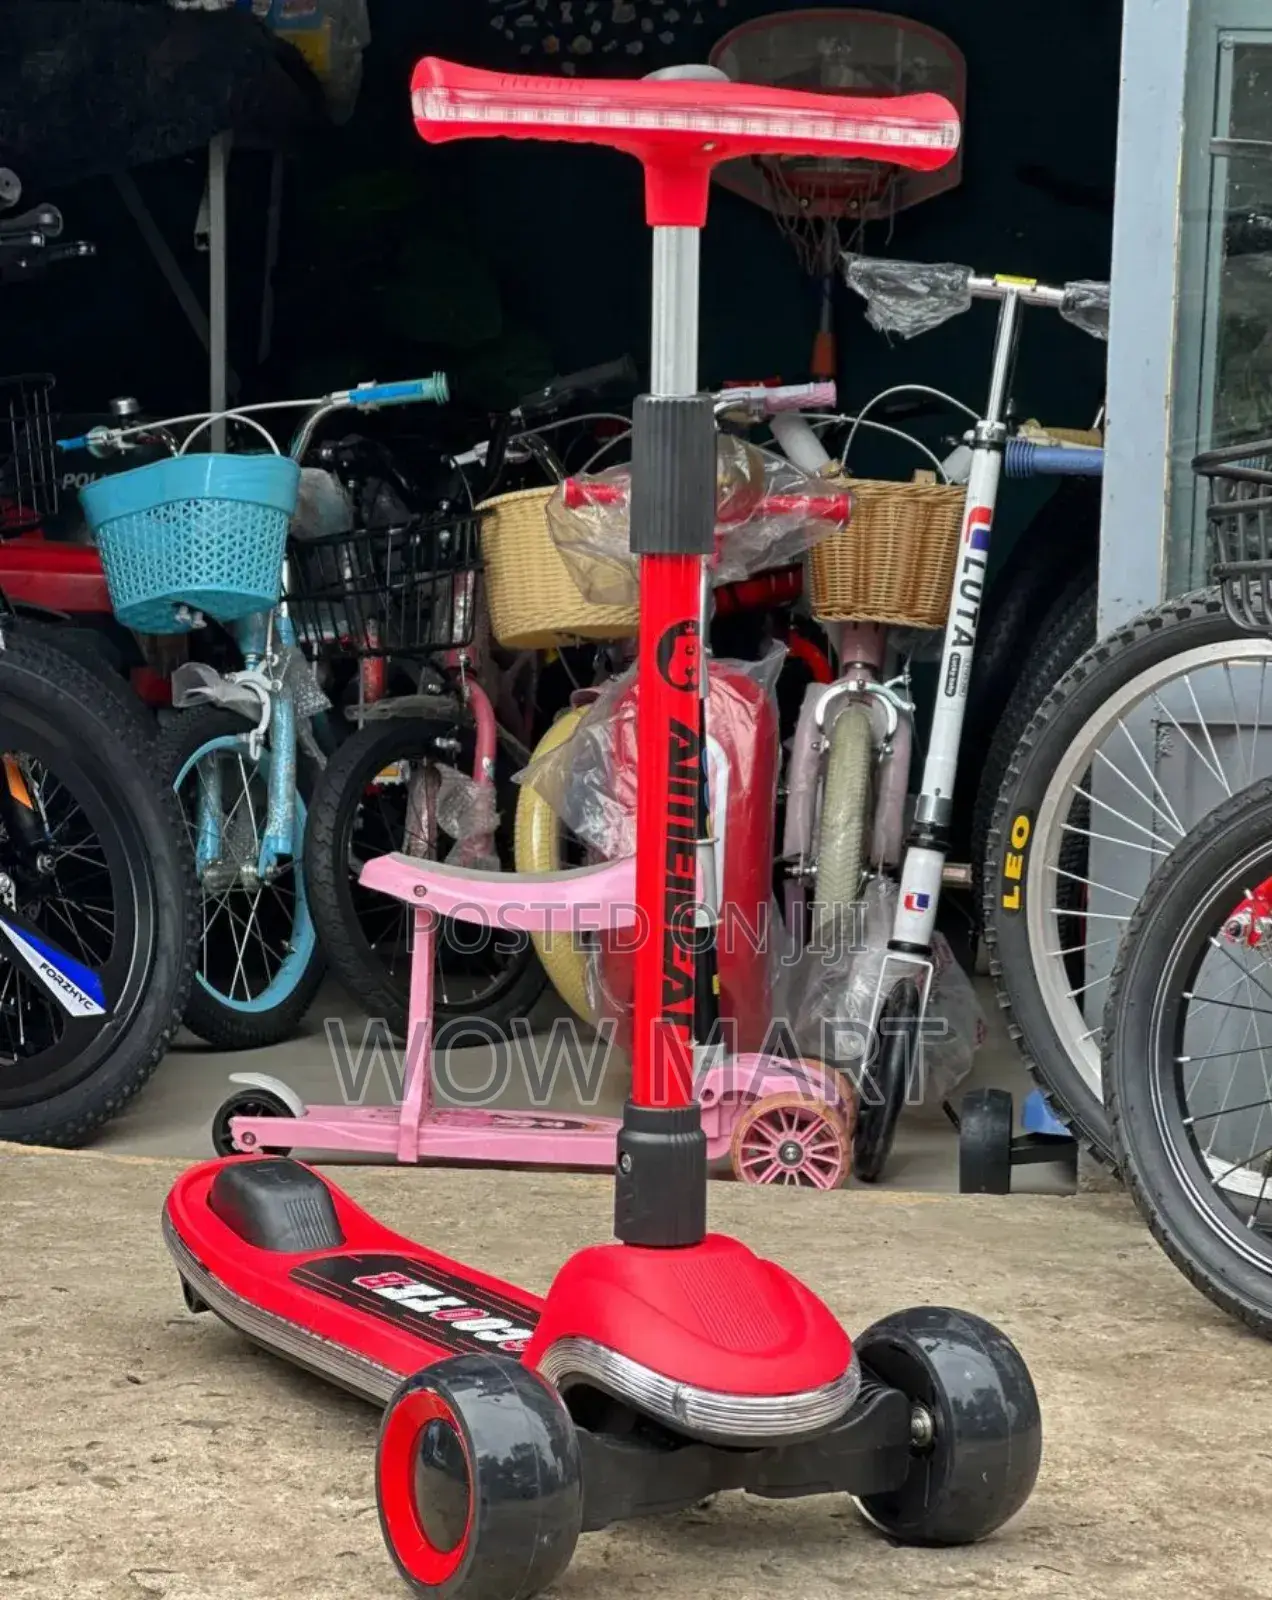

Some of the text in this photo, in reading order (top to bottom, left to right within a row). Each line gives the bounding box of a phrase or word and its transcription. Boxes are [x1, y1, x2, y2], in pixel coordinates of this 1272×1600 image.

[951, 555, 985, 647] LUTA
[1003, 815, 1030, 909] LEO
[40, 962, 94, 1010] FORZHYC
